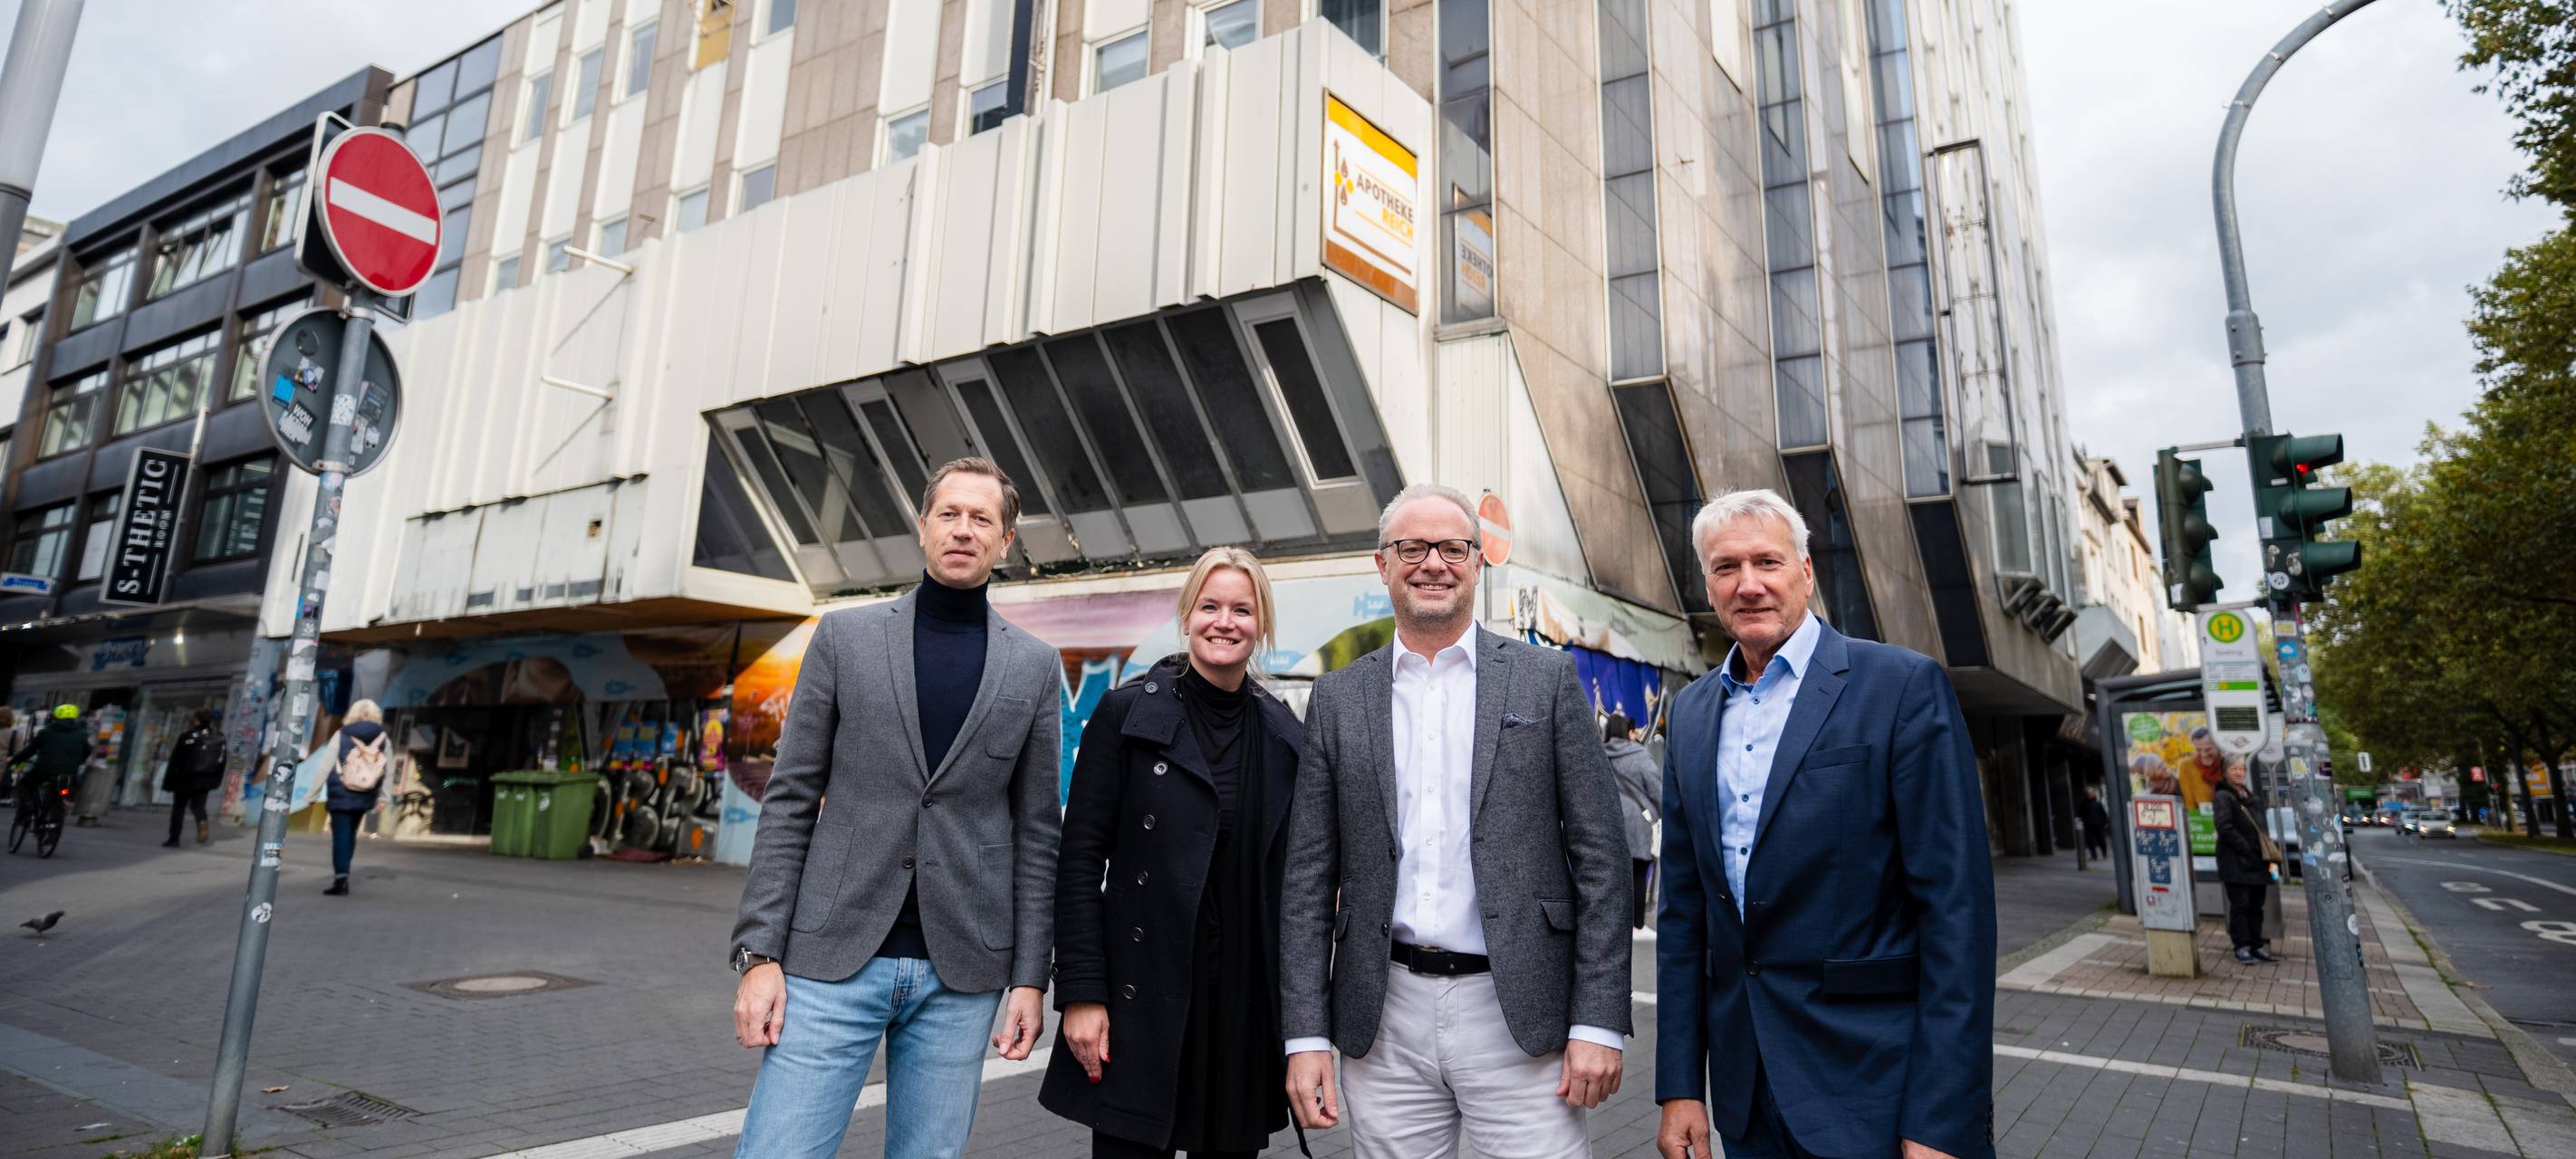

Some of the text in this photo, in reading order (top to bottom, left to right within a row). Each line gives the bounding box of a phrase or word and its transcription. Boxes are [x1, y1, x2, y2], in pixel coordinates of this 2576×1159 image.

[1357, 173, 1413, 224] APOTHEKE
[1381, 206, 1413, 240] REICH
[117, 459, 168, 594] S-THETIC
[154, 510, 172, 548] ROOM
